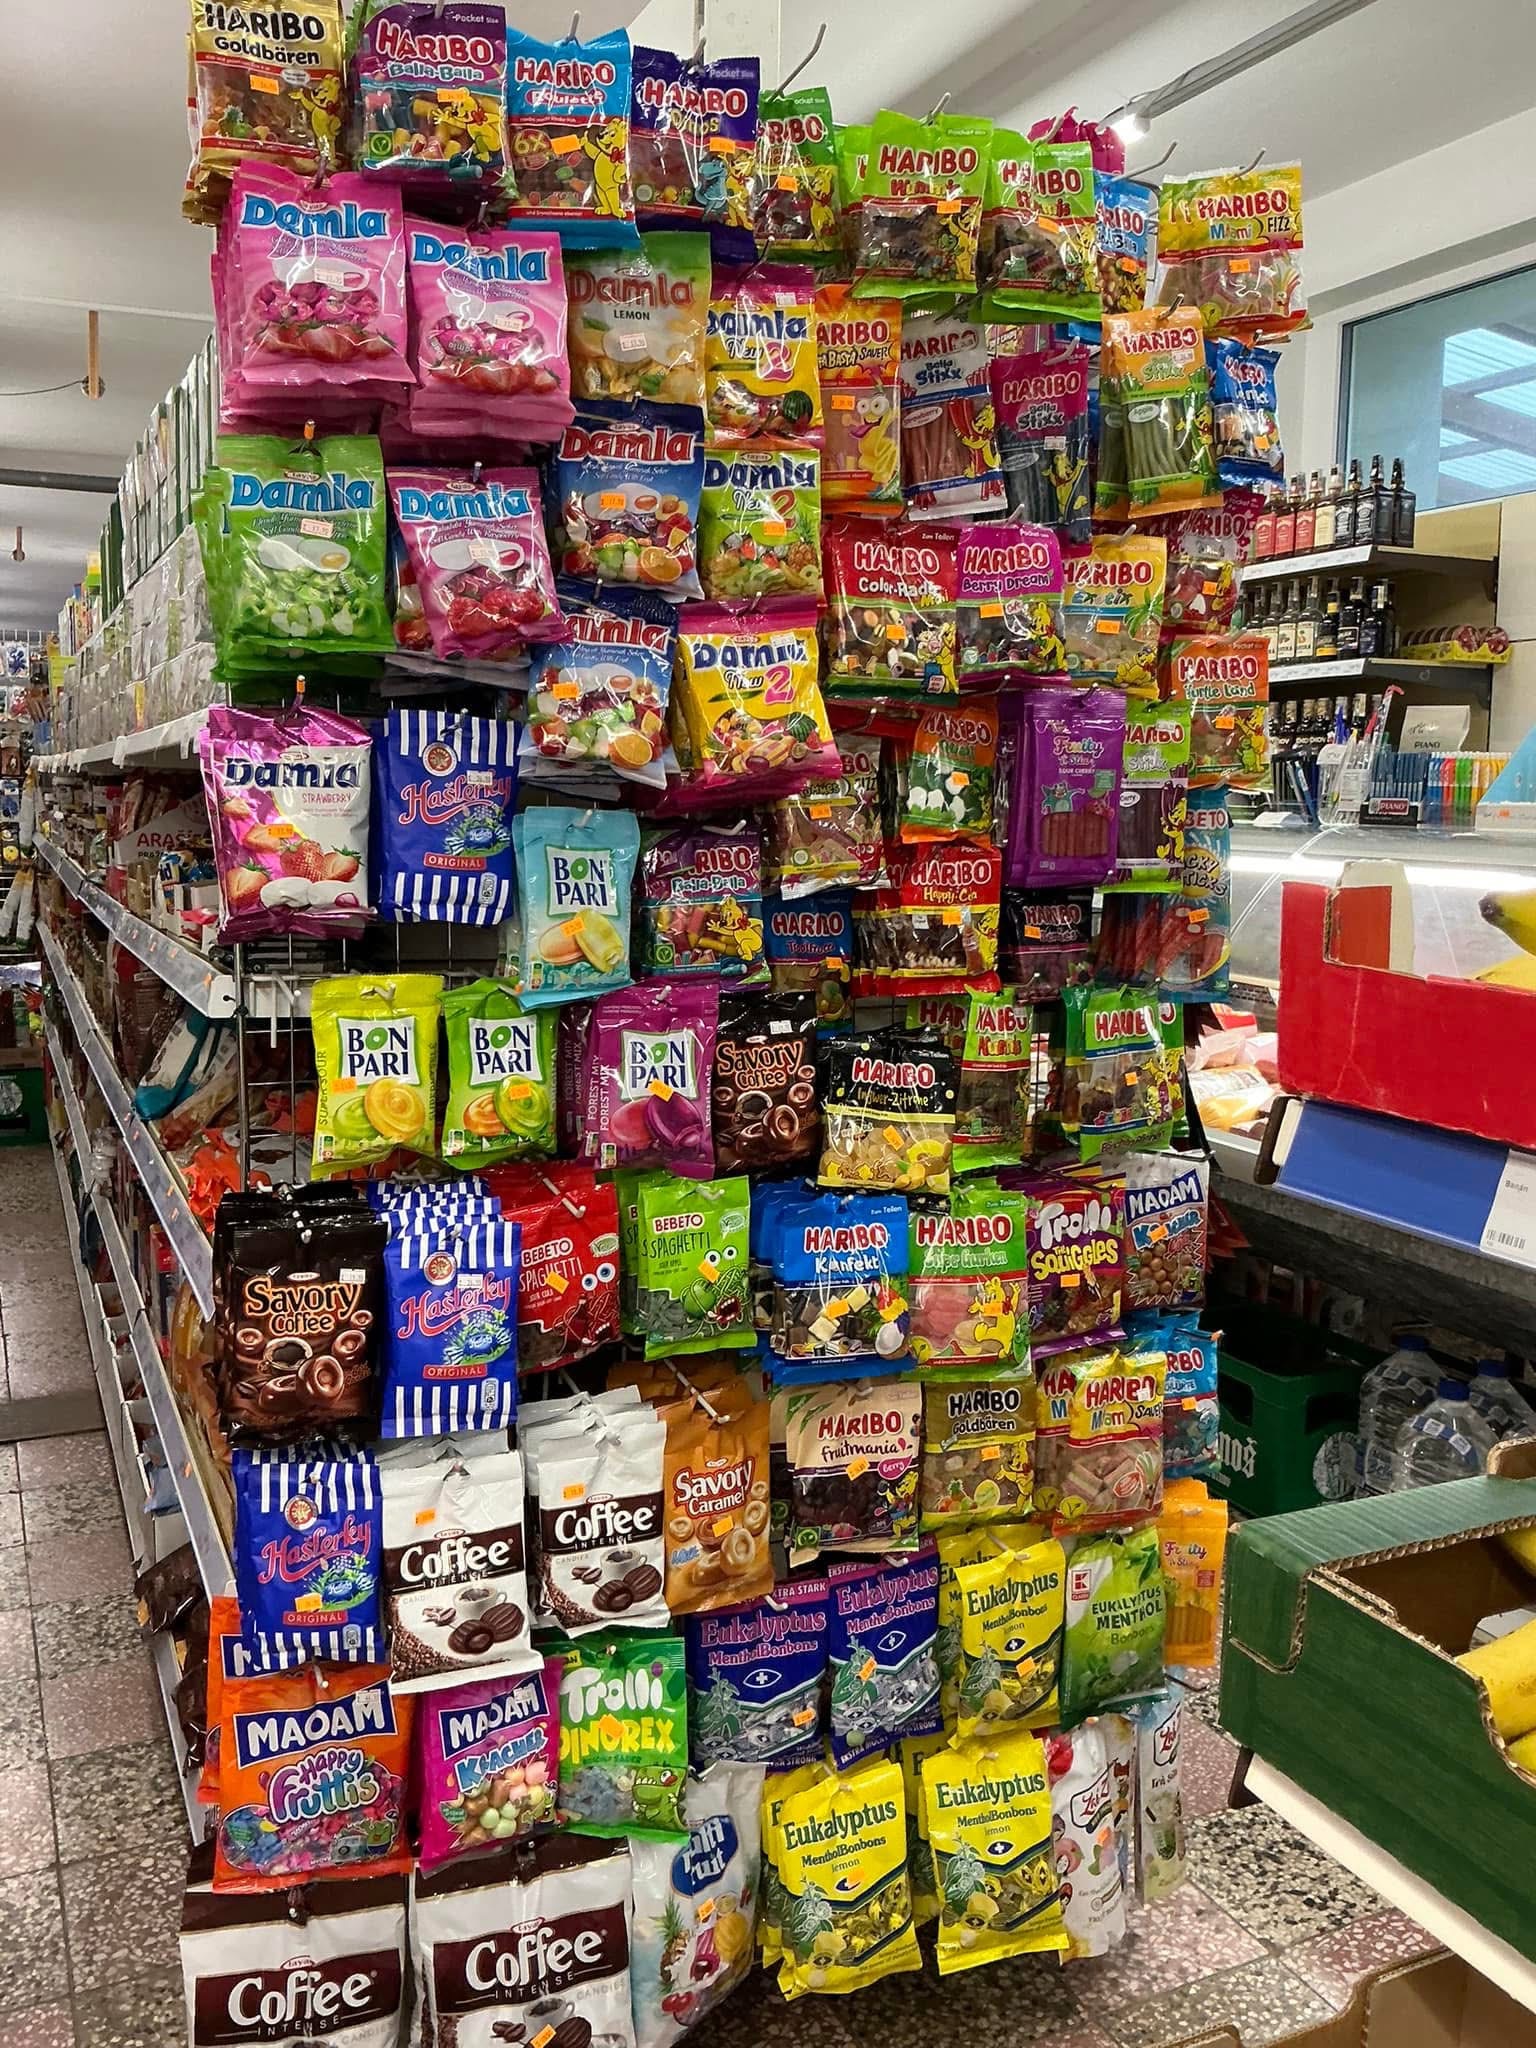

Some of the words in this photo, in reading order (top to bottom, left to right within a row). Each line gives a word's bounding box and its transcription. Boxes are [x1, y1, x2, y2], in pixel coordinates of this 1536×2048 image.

[206, 3, 324, 41] HARIBO
[214, 36, 320, 66] Goldbären
[376, 19, 493, 64] HARIBO
[387, 60, 484, 81] Balla-Balla
[516, 58, 616, 88] HARIBO
[643, 77, 748, 117] HARIBO
[241, 195, 390, 240] Damla
[1197, 188, 1290, 221] HARIBO
[411, 233, 548, 284] Damla
[567, 271, 694, 309] Damla
[613, 309, 651, 321] LEMON
[1122, 327, 1199, 355] HARIBO
[1001, 371, 1082, 404] HARIBO
[562, 427, 694, 461] Damla
[704, 455, 816, 490] Damla
[230, 473, 377, 514] Damla
[399, 483, 532, 522] Damla
[962, 543, 1050, 575] HARIBO
[962, 577, 1001, 593] Berry
[1062, 560, 1153, 590] HARIBO
[564, 612, 672, 654] amla
[1178, 655, 1260, 682] HARIBO
[763, 664, 796, 706] 2
[1414, 741, 1441, 750] PIANO
[302, 792, 352, 804] STRAWBERRY
[1379, 800, 1408, 811] PIANO
[1184, 810, 1227, 830] BETO
[428, 855, 482, 868] ORIGINAL
[553, 856, 605, 881] BON
[694, 846, 752, 874] RIBO
[910, 859, 992, 886] HARIBO
[555, 880, 609, 907] PARI
[347, 1026, 409, 1053] BON
[475, 1025, 531, 1052] BON
[630, 1040, 686, 1067] BON
[348, 1050, 410, 1078] PARI
[477, 1049, 533, 1075] PARI
[716, 1041, 802, 1075] Savory
[851, 1057, 936, 1089] HARIBO
[631, 1064, 688, 1090] PARI
[735, 1069, 786, 1090] Coffee
[600, 1089, 611, 1133] FOREST
[1129, 1180, 1199, 1219] MAOAM
[1504, 1179, 1529, 1193] Banán
[654, 1214, 704, 1232] BEBETO
[804, 1222, 888, 1253] HARIBO
[917, 1214, 1013, 1247] HARIBO
[1034, 1200, 1112, 1250] Trolli
[523, 1240, 571, 1264] BEBETO
[649, 1230, 711, 1259] SPAGHETTI
[814, 1254, 881, 1275] Konfekt
[244, 1276, 361, 1320] Savory
[270, 1312, 335, 1336] Coffee
[427, 1366, 483, 1377] ORIGINAL
[948, 1389, 1021, 1418] HARIBO
[818, 1411, 902, 1440] HARIBO
[953, 1417, 1016, 1435] Goldbären
[676, 1459, 756, 1501] Savory
[881, 1462, 905, 1473] Berry
[687, 1487, 744, 1517] Caramel
[555, 1501, 655, 1546] Coffee
[258, 1514, 372, 1585] Hašlerky
[400, 1537, 511, 1582] Coffee
[422, 1570, 490, 1589] INTENSE
[797, 1581, 827, 1595] STARK
[837, 1566, 939, 1615] Eukalyptus
[965, 1569, 1060, 1618] Eukalyptus
[287, 1611, 343, 1624] ORIGINAL
[701, 1608, 827, 1648] Eukalyptus
[1095, 1599, 1164, 1631] MENTHOL
[708, 1640, 819, 1667] MentholBonbons
[560, 1667, 663, 1724] Trolli
[247, 1699, 386, 1758] MAOAM
[449, 1683, 540, 1749] MAOAM
[300, 1749, 364, 1785] Happy
[457, 1729, 546, 1791] KRACHER
[935, 1772, 1046, 1809] Eukalyptus
[783, 1800, 899, 1851] Eukalyptus
[957, 1805, 1038, 1828] MentholBonbons
[984, 1824, 1012, 1837] lemon
[801, 1836, 887, 1868] MentholBonbons
[830, 1857, 861, 1874] lemon
[465, 1926, 604, 1992] Coffee
[228, 1970, 372, 2027] Coffee
[494, 1970, 575, 1999] INTENSE
[256, 2014, 341, 2037] INTENSE
